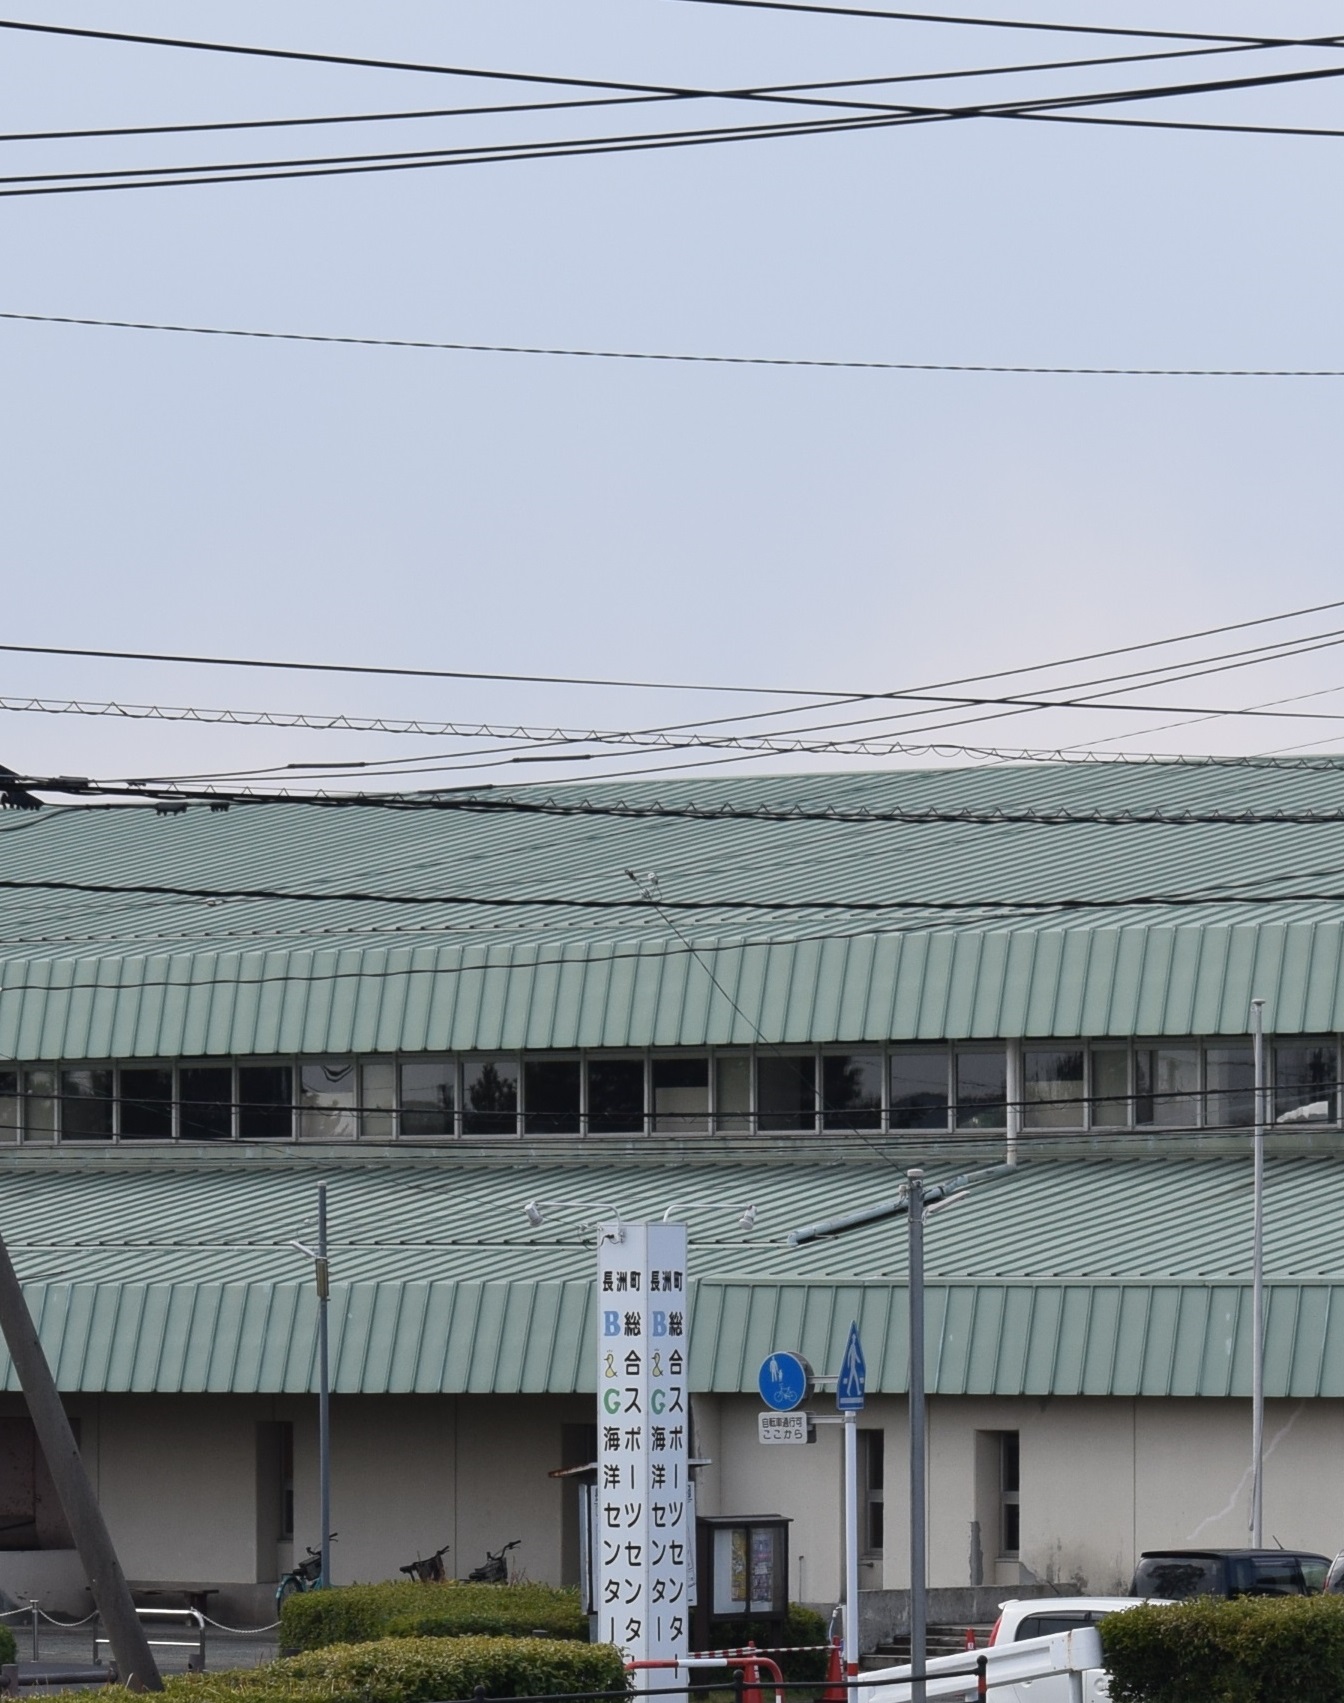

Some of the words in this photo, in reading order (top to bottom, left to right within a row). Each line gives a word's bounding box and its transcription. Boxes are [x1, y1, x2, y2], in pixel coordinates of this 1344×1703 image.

[603, 1270, 641, 1292] 長洲町
[650, 1270, 683, 1292] 長洲町
[763, 1429, 803, 1440] ここから
